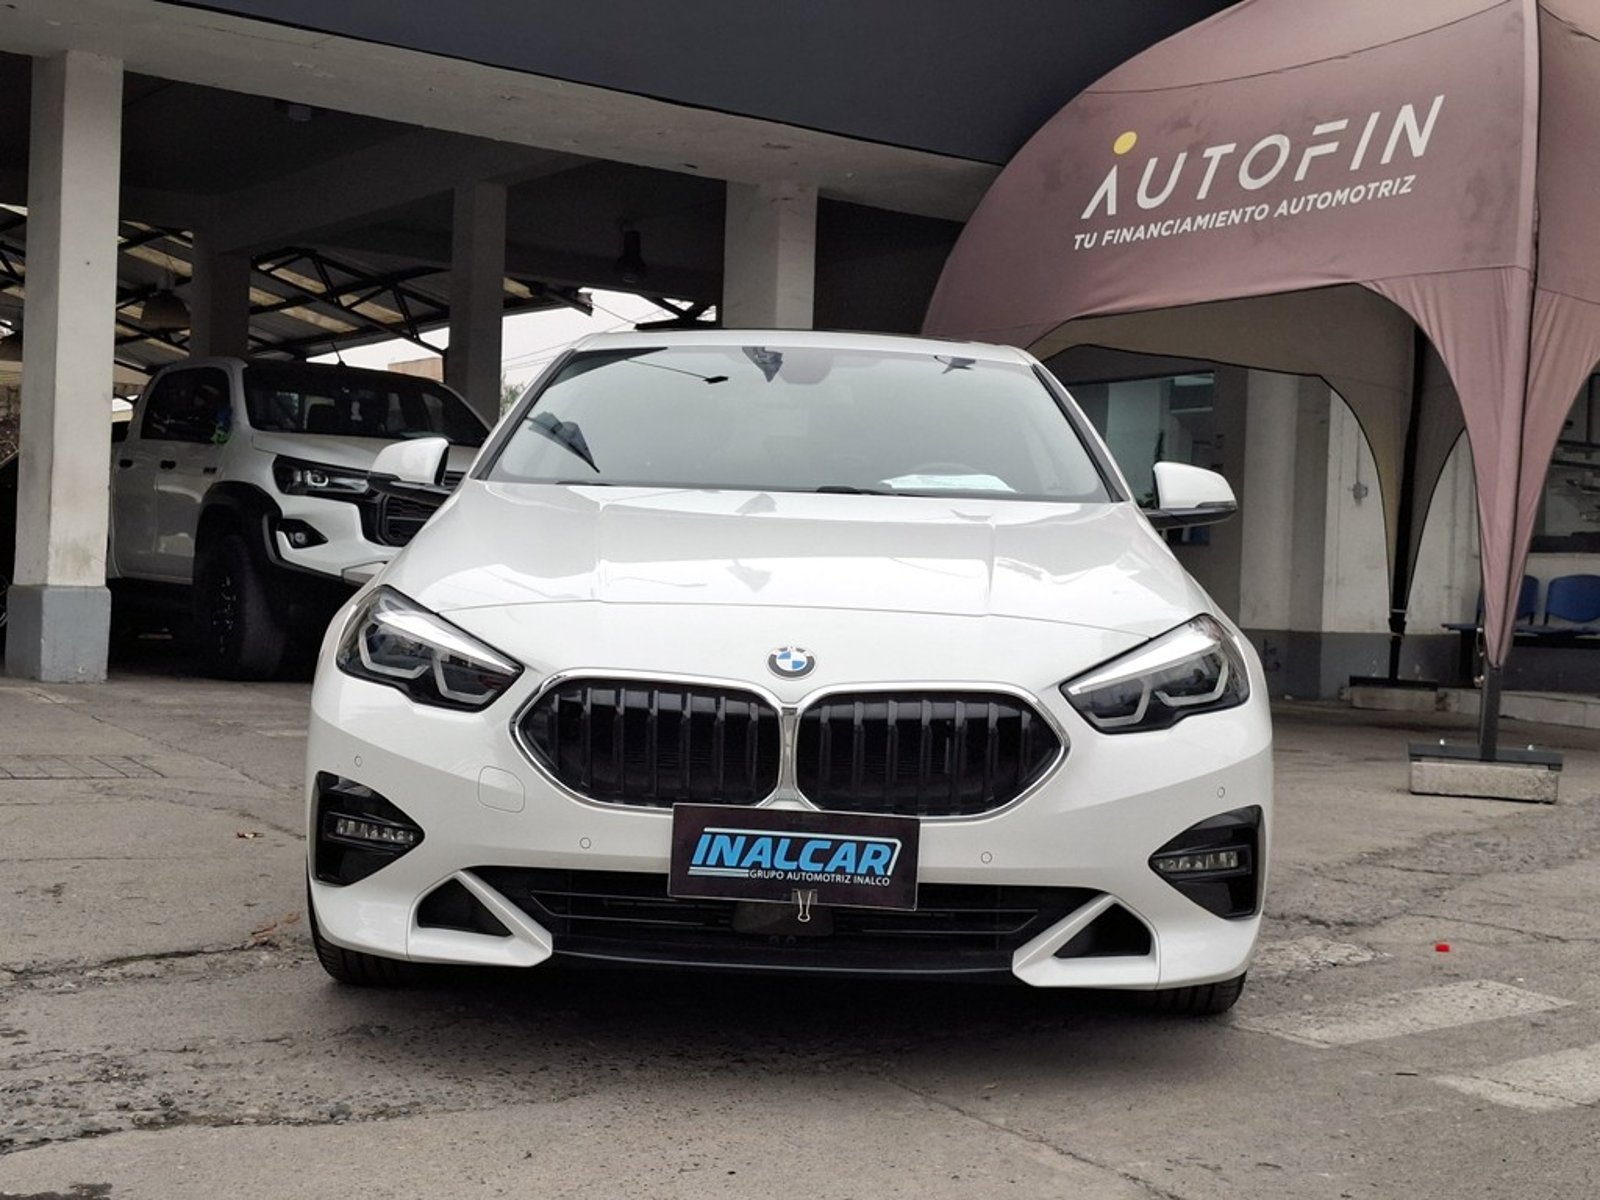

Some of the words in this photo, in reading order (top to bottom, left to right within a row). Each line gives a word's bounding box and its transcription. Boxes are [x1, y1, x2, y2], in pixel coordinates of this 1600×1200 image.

[1080, 94, 1446, 220] AUTOFIN
[1073, 232, 1096, 250] TU
[1102, 203, 1269, 246] FINANCIAMIENTO
[1274, 174, 1417, 217] AUTOMOTRIZ
[691, 834, 892, 875] INALCAR
[749, 870, 784, 881] GRUPO
[786, 871, 851, 884] AUTOMOTRIZ
[853, 875, 890, 887] INALCO
